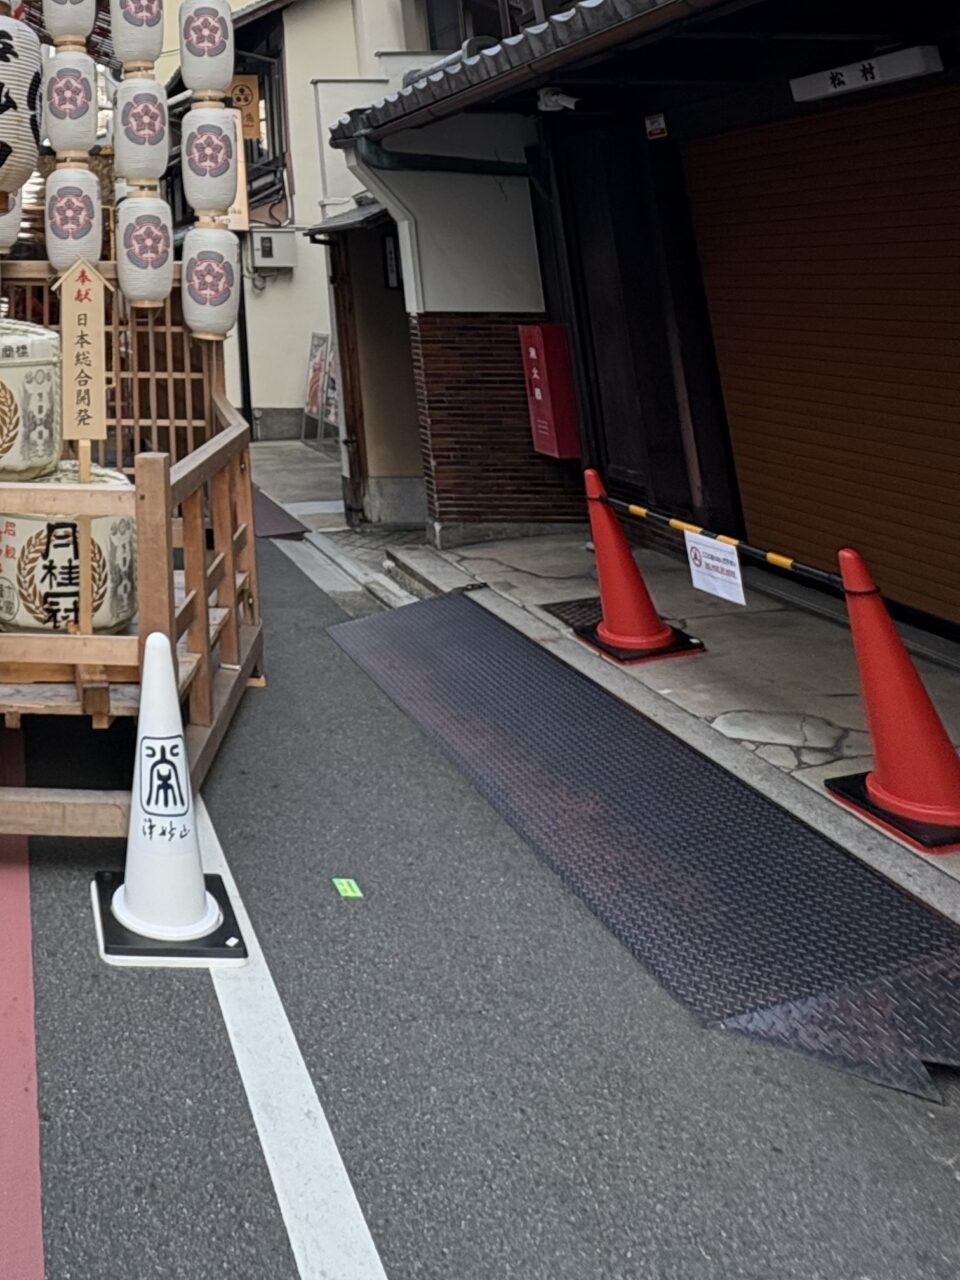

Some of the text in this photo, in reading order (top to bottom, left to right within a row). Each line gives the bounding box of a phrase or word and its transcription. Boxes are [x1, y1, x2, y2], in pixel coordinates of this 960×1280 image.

[829, 62, 876, 89] 松村
[73, 312, 93, 427] 日本総合開発
